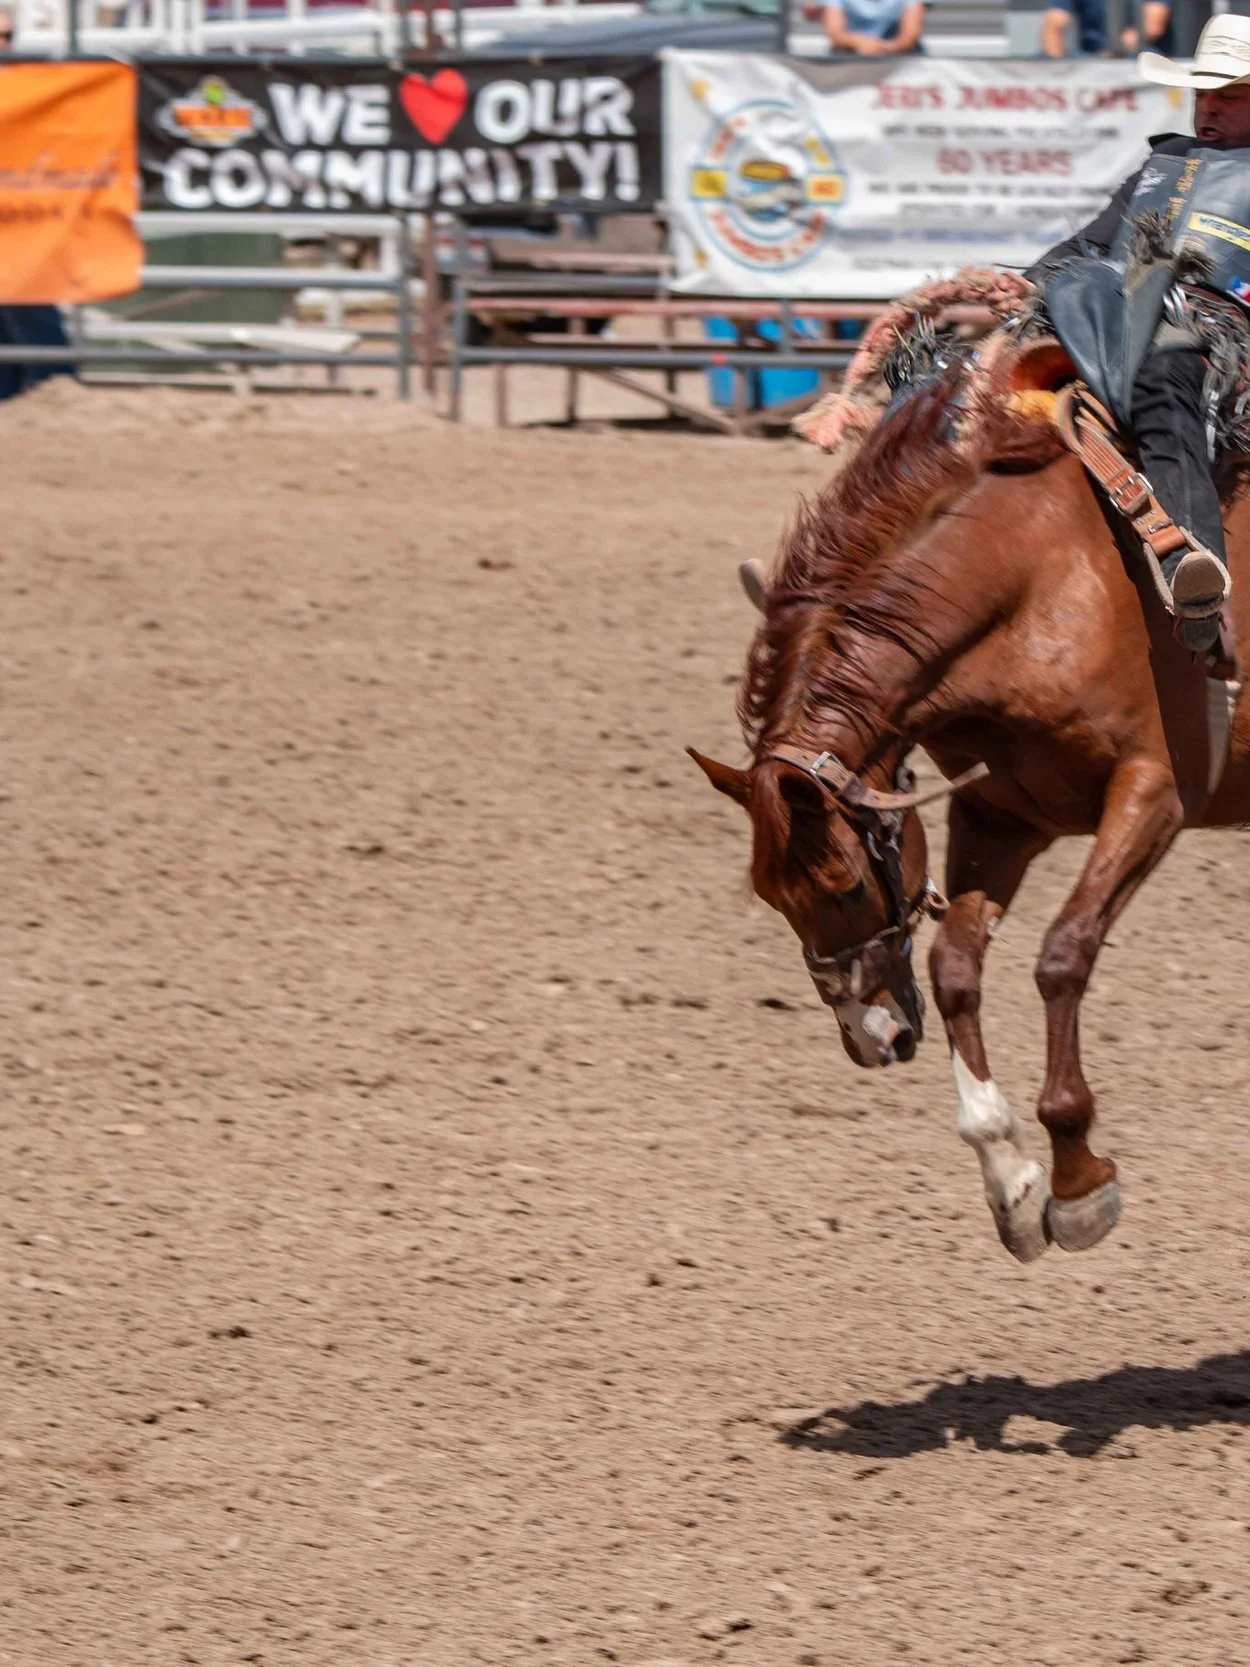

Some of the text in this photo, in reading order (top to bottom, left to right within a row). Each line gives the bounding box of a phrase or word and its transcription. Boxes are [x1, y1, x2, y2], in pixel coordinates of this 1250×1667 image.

[266, 82, 392, 146] WE
[474, 76, 637, 143] OUR
[162, 143, 640, 210] COMMUNITY!
